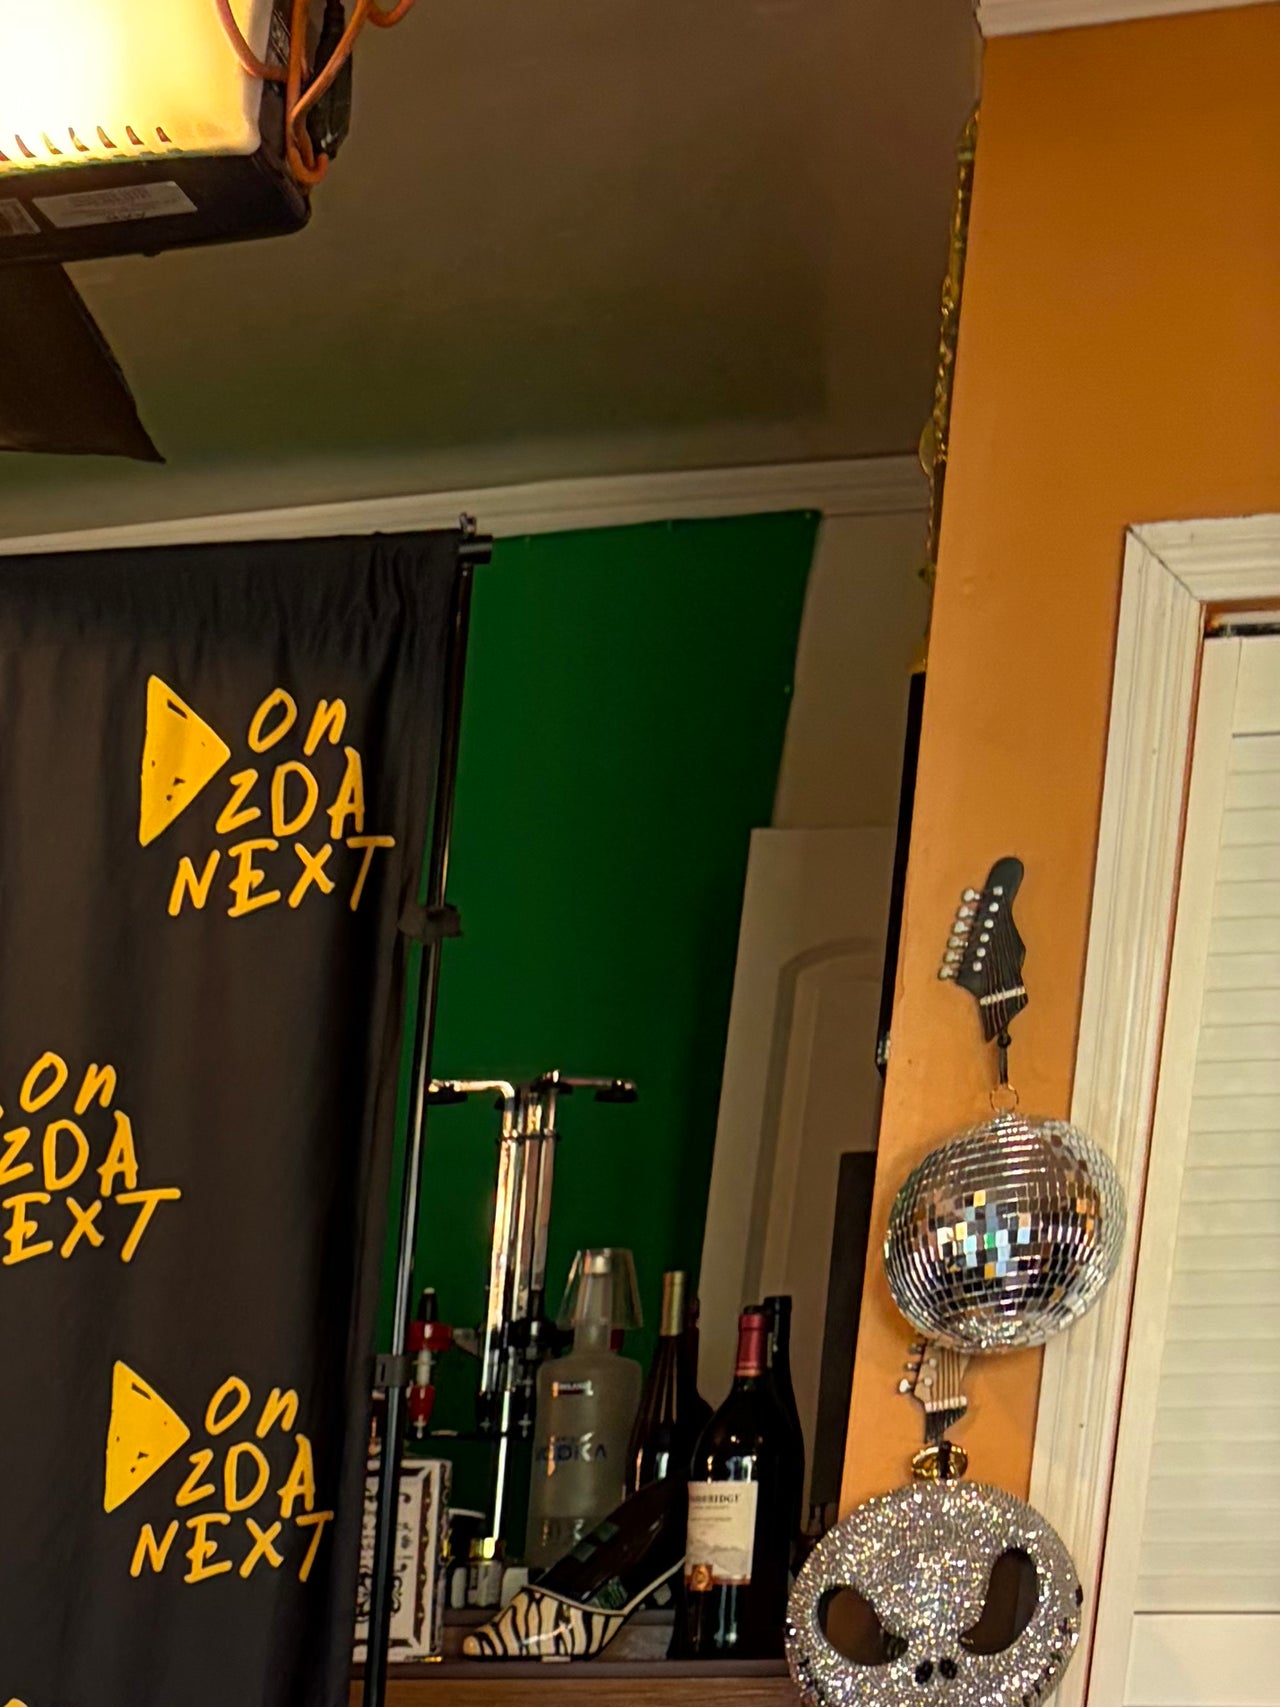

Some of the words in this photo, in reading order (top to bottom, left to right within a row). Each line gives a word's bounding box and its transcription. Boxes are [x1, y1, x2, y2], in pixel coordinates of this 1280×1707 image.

[247, 688, 347, 757] On
[167, 836, 396, 918] NEXT
[19, 1051, 117, 1115] On
[204, 1376, 299, 1439] On
[130, 1512, 333, 1584] NEXT
